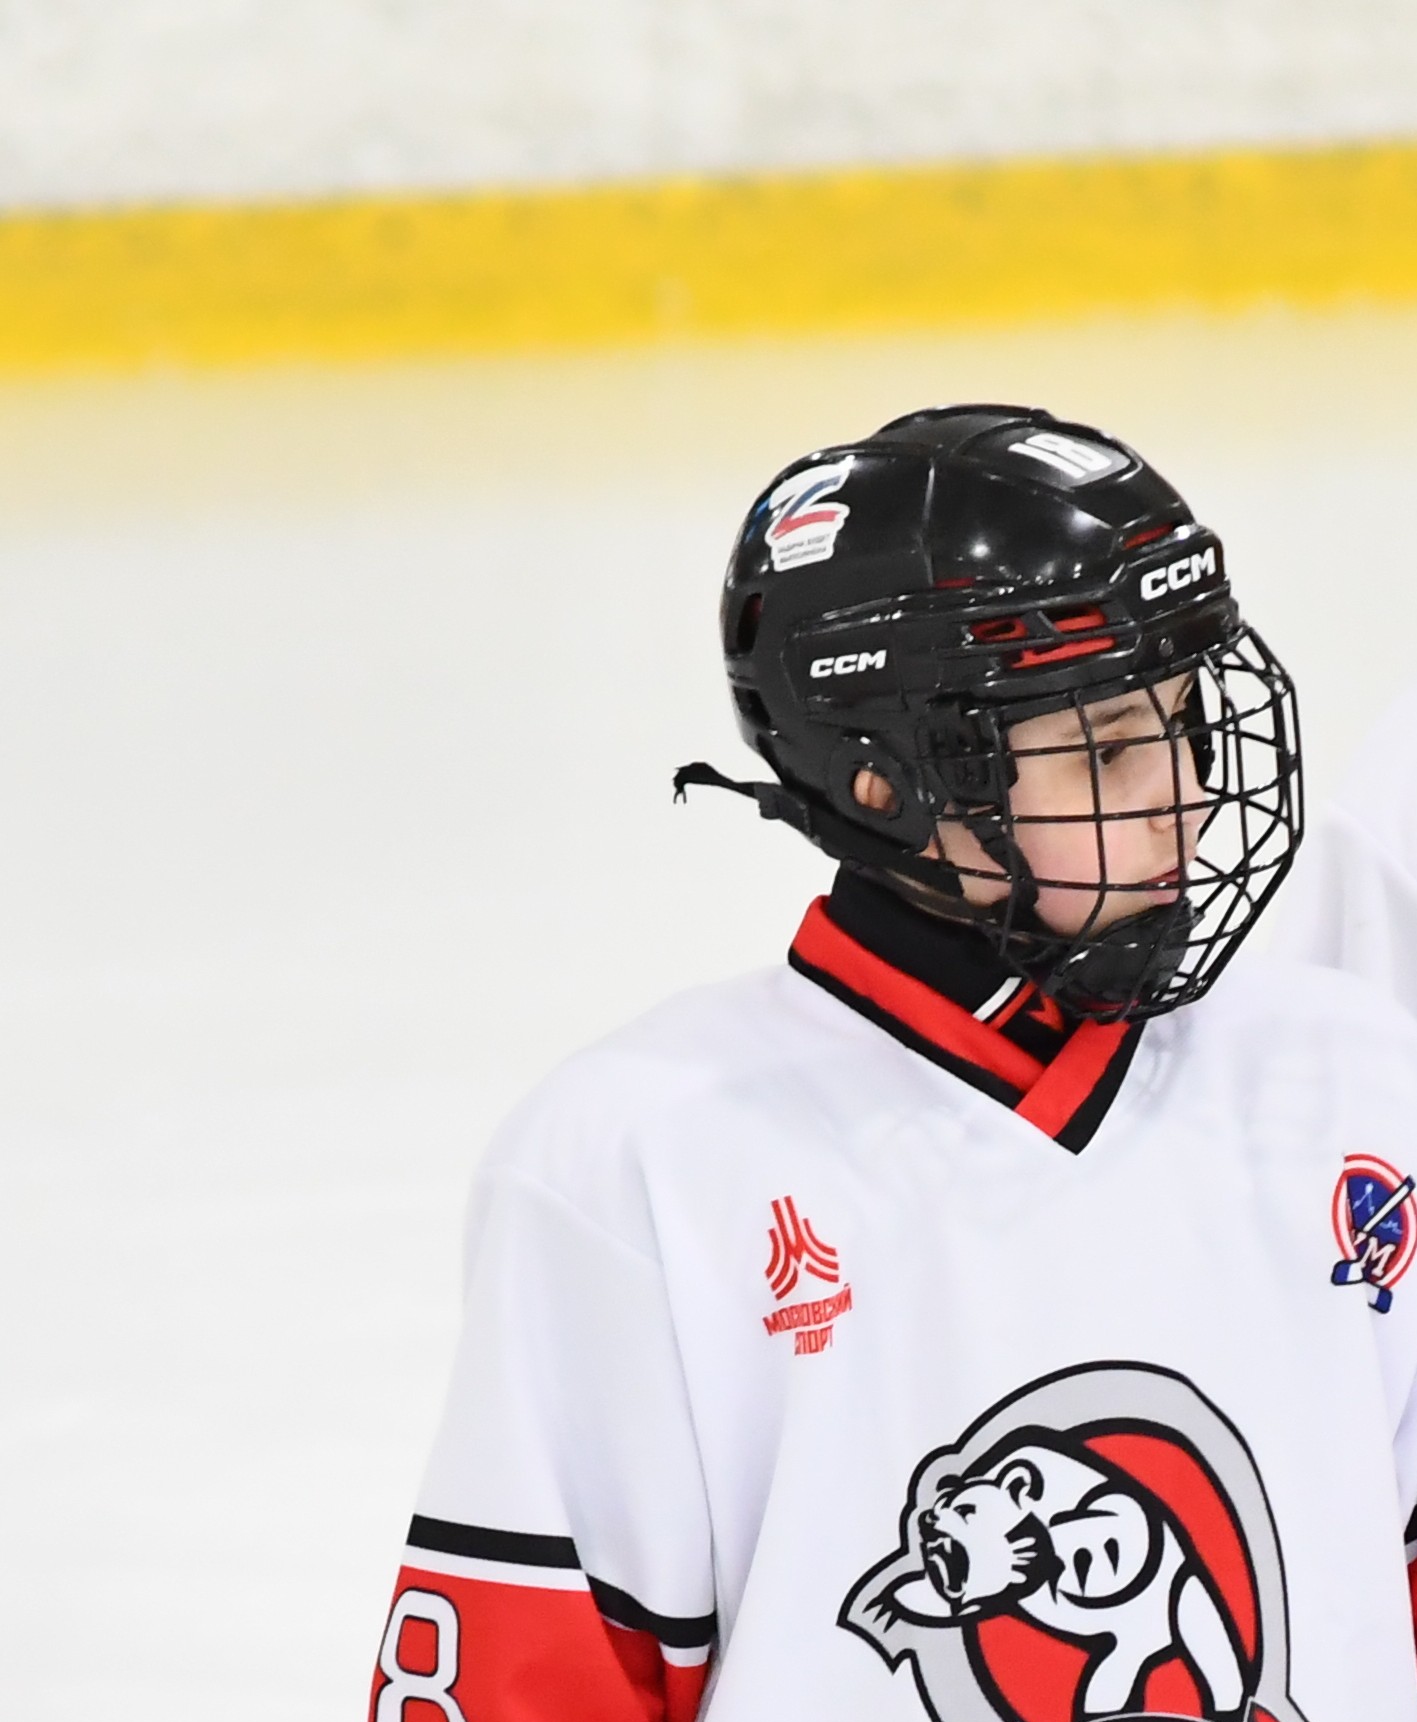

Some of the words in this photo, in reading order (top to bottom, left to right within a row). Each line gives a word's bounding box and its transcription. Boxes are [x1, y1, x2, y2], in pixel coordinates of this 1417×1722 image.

[1007, 433, 1112, 479] 18
[1140, 548, 1216, 600] CCM
[809, 650, 887, 678] CCM
